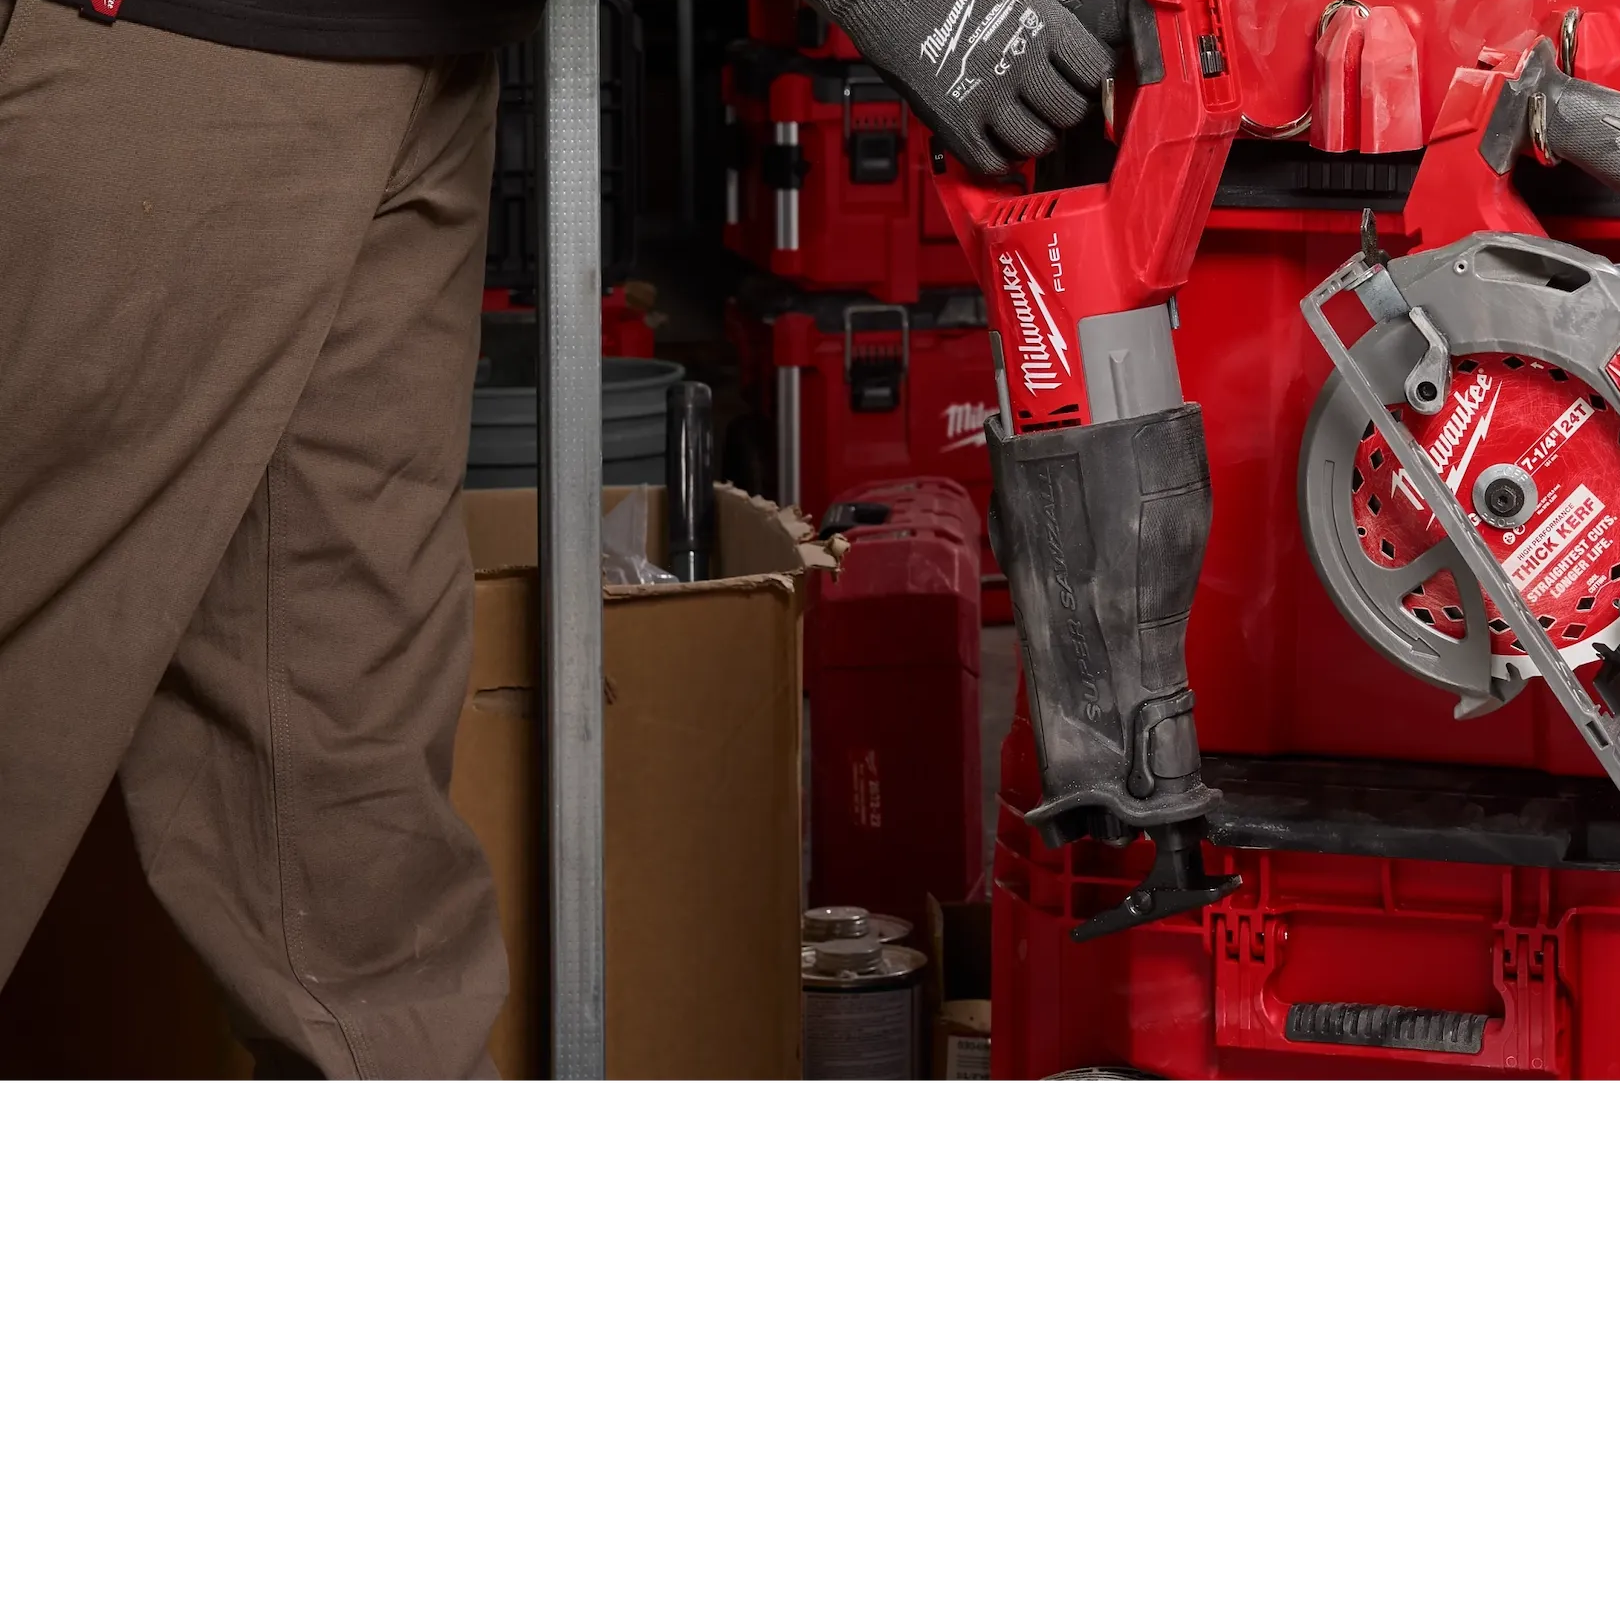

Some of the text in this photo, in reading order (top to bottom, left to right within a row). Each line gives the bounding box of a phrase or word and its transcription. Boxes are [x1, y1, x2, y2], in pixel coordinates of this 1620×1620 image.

[968, 26, 982, 43] CUT
[981, 2, 1004, 26] LEVEL
[1048, 232, 1066, 292] FUEL
[998, 251, 1063, 398] Milwaukee
[1390, 371, 1493, 511] Mlwaukee
[1520, 429, 1559, 471] 7-1/4"
[1560, 403, 1587, 433] 24T
[1512, 536, 1560, 581] THICK
[1555, 497, 1595, 539] KERF
[1517, 543, 1534, 561] HIGH
[1532, 502, 1575, 547] PERFORMANCE
[1527, 514, 1618, 603] STRAIGHTEST CUTS.
[1549, 537, 1614, 599] LONGER LIFE.
